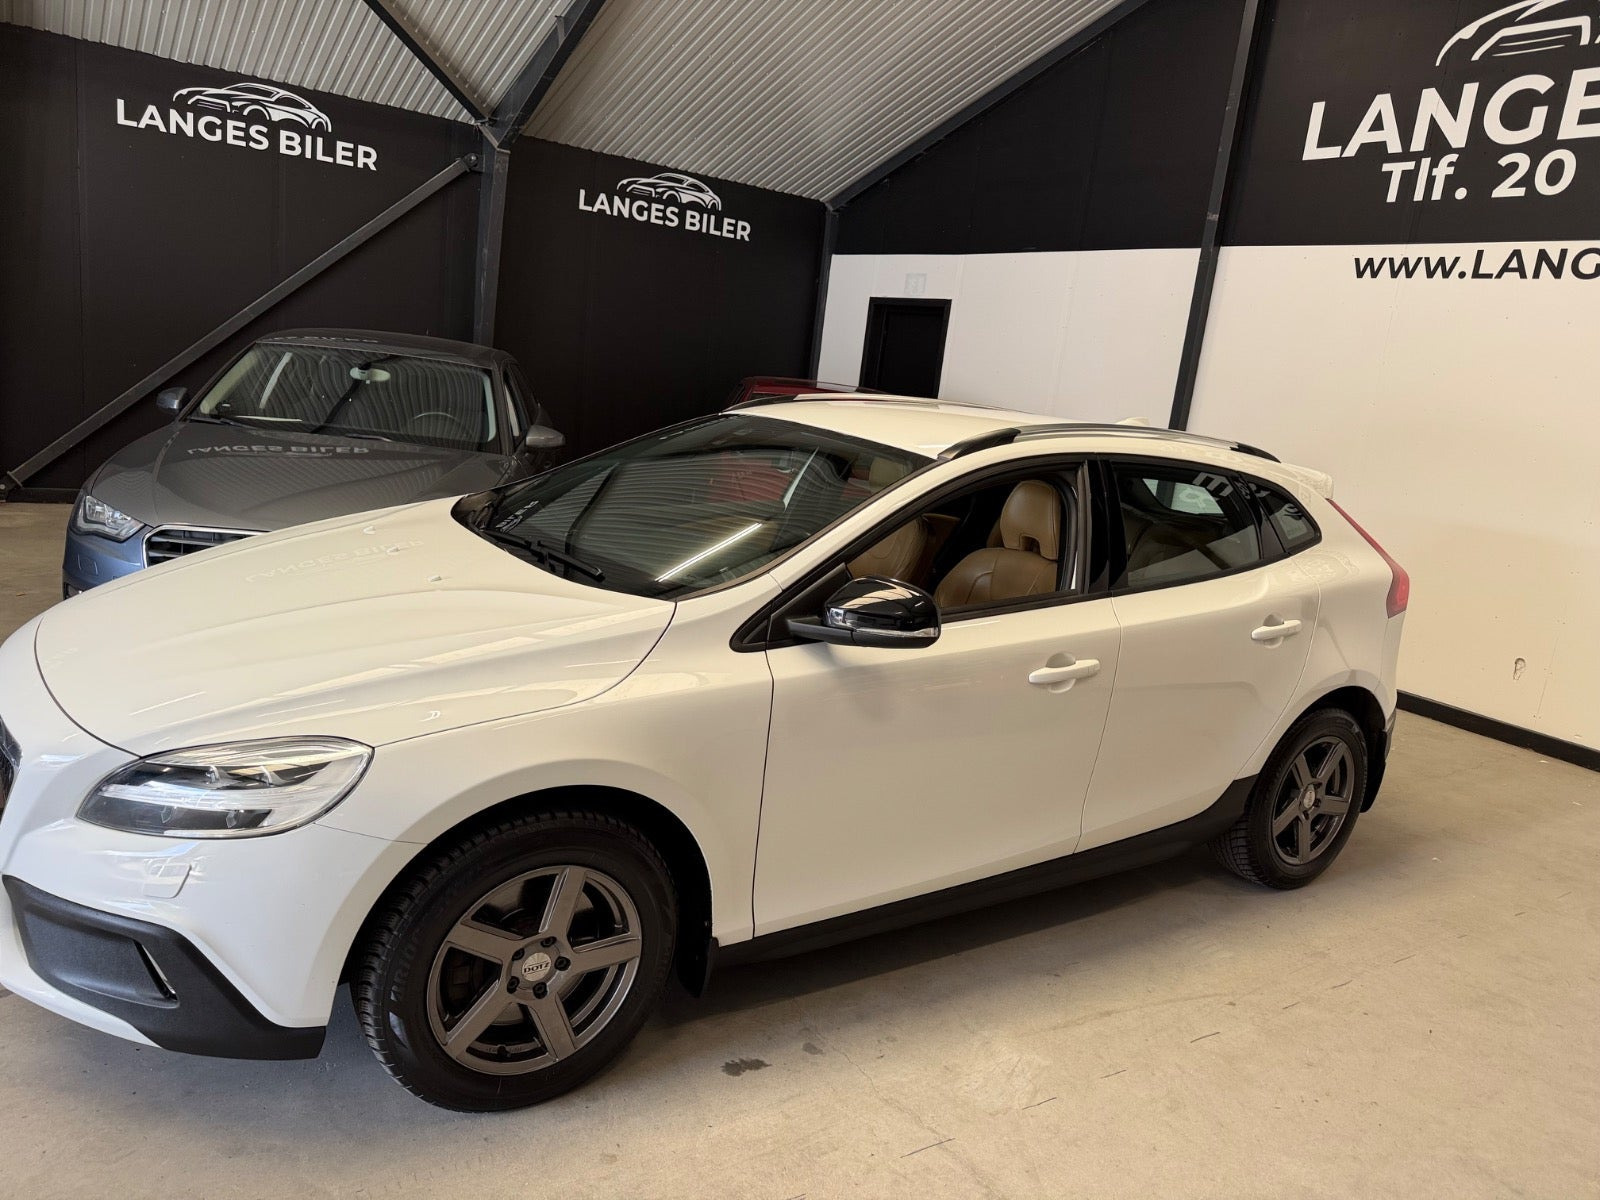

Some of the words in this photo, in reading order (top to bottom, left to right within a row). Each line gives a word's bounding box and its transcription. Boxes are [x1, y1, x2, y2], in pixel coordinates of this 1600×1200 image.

[116, 98, 270, 151] LANGES
[279, 129, 378, 171] BILER
[1381, 153, 1468, 203] Tlf.
[1491, 149, 1577, 198] 20
[578, 188, 680, 228] LANGES
[684, 209, 752, 242] BILER
[1353, 247, 1600, 280] www.LANG
[523, 961, 550, 974] DOTZ
